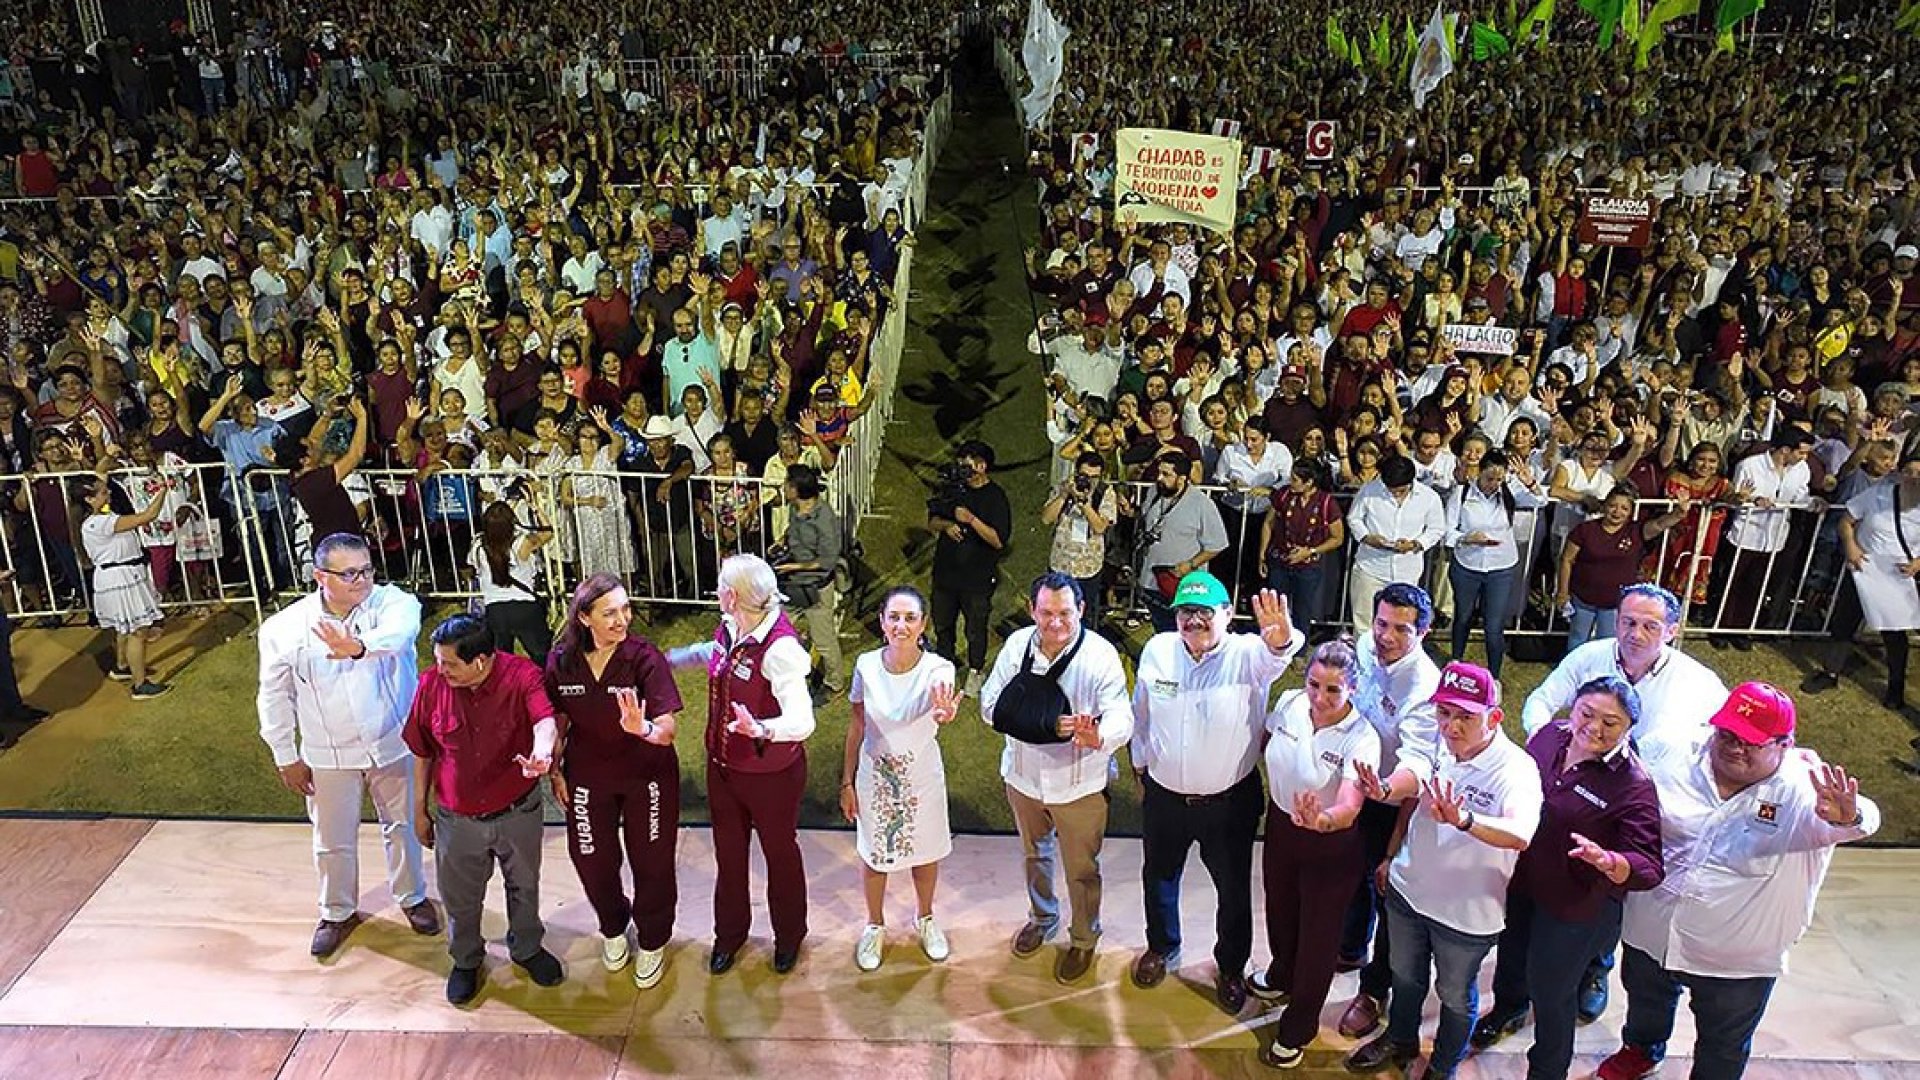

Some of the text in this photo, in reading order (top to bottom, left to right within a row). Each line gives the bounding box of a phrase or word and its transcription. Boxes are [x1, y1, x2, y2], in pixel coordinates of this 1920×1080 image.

[1309, 122, 1334, 156] G
[1137, 147, 1206, 167] CHAPAB
[1125, 163, 1202, 183] TERRITORIO
[1132, 180, 1199, 199] MORENA
[574, 786, 595, 855] morena
